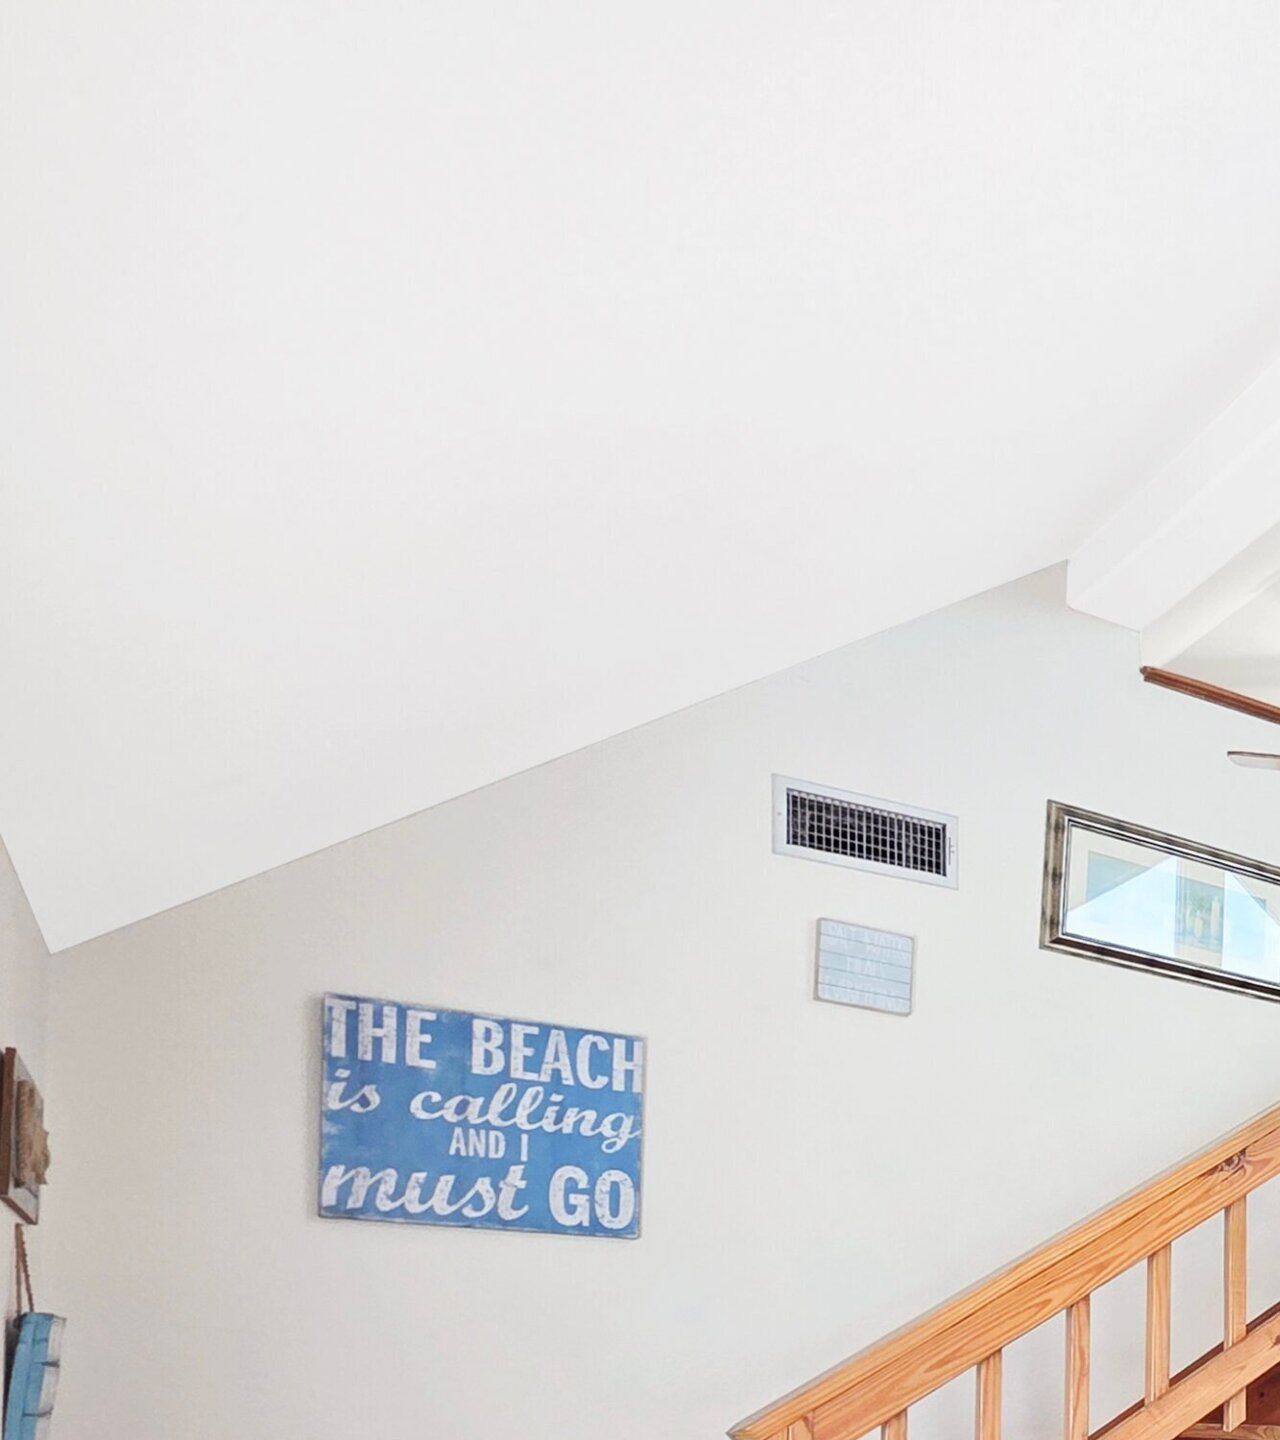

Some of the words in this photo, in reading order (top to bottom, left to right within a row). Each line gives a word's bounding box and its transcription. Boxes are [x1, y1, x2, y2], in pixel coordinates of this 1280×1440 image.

[325, 998, 437, 1069] THE
[471, 1018, 643, 1093] BEACH
[325, 1068, 381, 1113] is
[409, 1082, 642, 1154] calling
[448, 1126, 506, 1159] AND
[520, 1133, 529, 1161] I
[321, 1163, 529, 1221] must
[549, 1165, 635, 1229] GO
